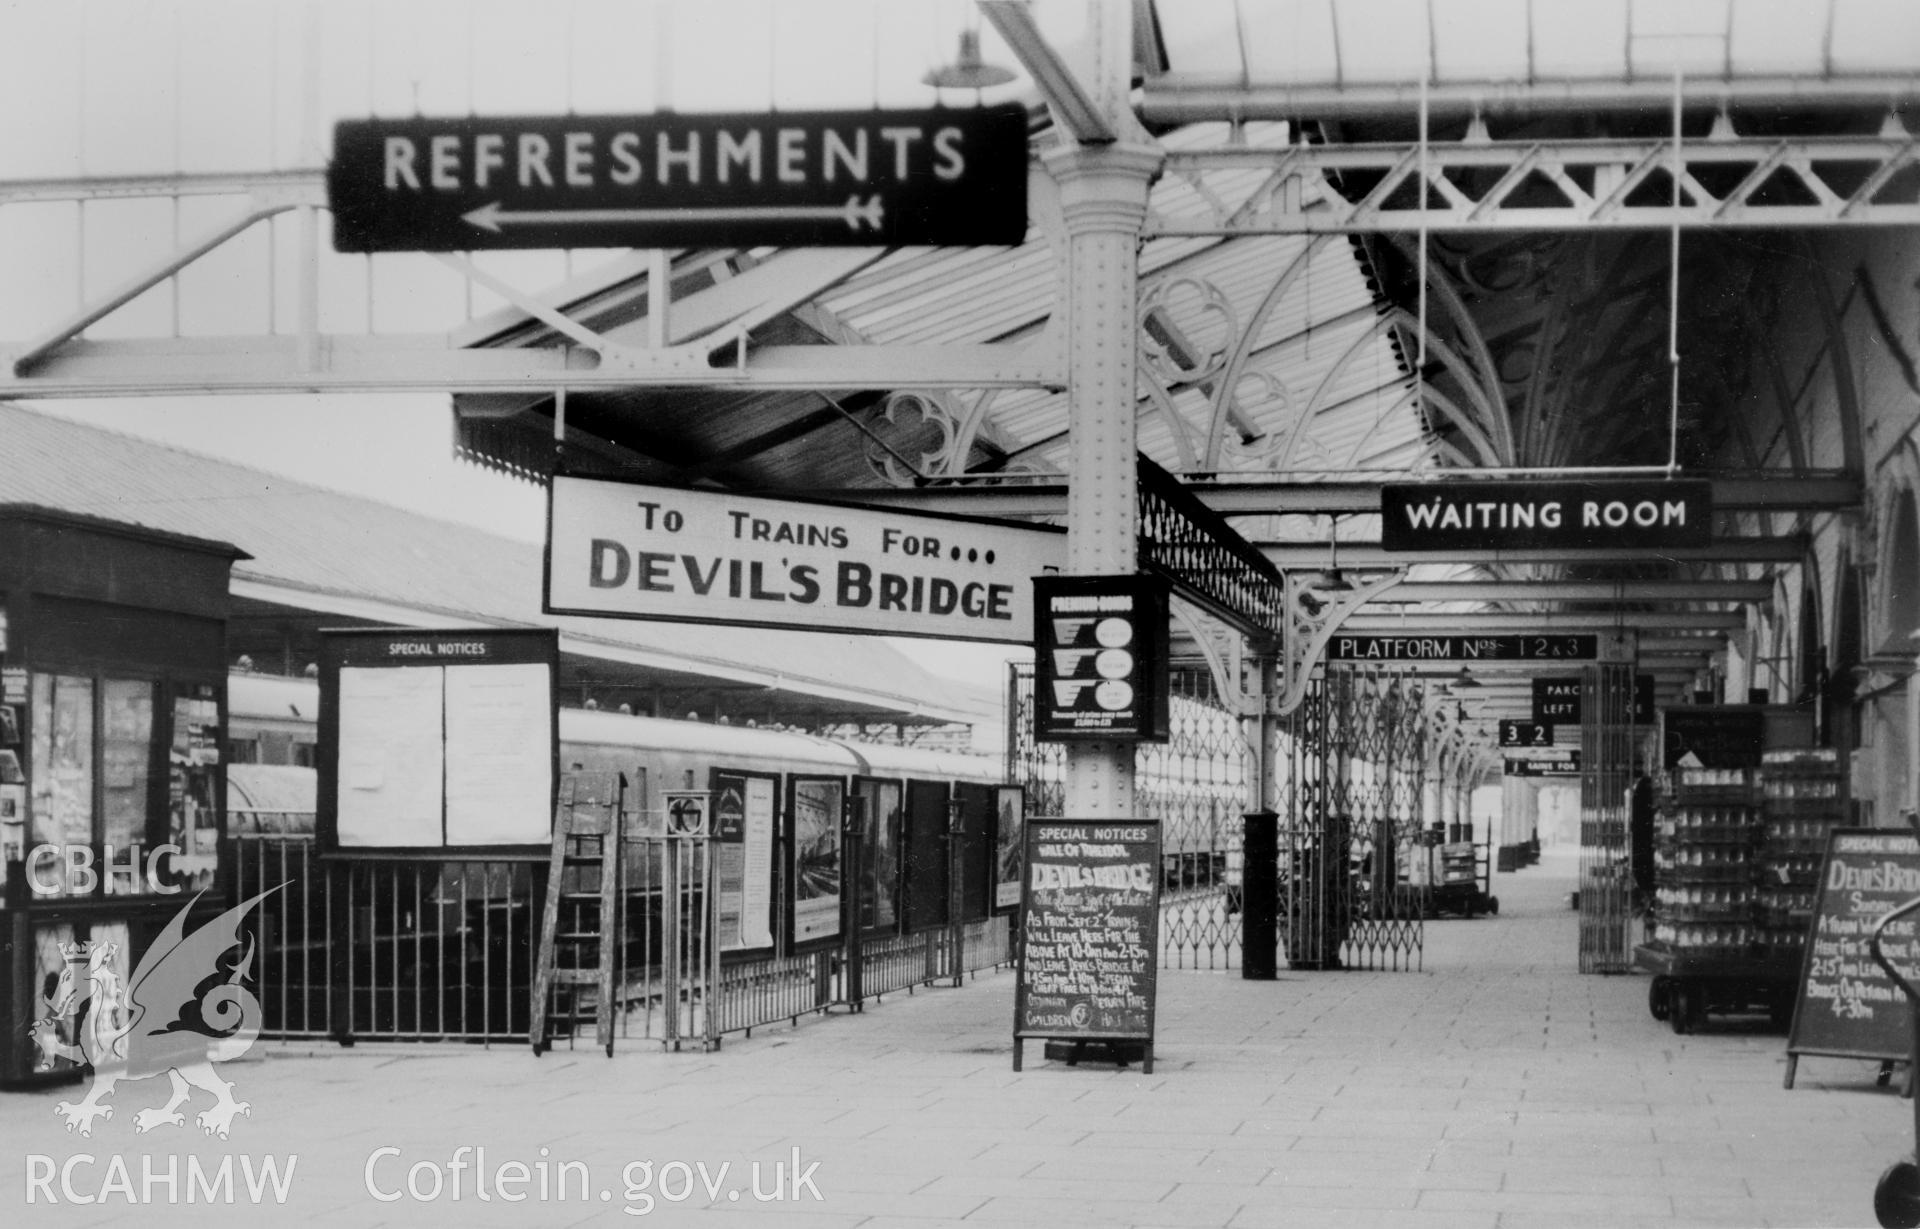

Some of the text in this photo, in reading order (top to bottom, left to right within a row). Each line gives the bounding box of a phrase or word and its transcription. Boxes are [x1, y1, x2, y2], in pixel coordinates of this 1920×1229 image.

[383, 126, 965, 189] REFRESHMENTS
[1406, 501, 1686, 529] WAITING ROOM
[589, 538, 1015, 620] DEVIL'S BRIDGE
[389, 642, 486, 655] SPECIAL NOTICES
[1340, 638, 1451, 658] PLATFORM
[1535, 637, 1547, 657] 2
[1567, 638, 1579, 656] 3
[1543, 704, 1574, 714] LEFT
[1508, 725, 1545, 741] 3 2
[1557, 761, 1576, 771] FOR
[1038, 828, 1148, 840] SPECIAL NOTICES
[1840, 838, 1884, 851] SPECIAL
[1092, 862, 1153, 892] BRIDGE
[1828, 860, 1920, 892] DEVIL'S BRID
[1026, 909, 1042, 927] AS
[1043, 911, 1067, 927] FROM
[1818, 914, 1827, 934] A
[1025, 926, 1142, 943] WILL LEAVE HERE FOR THE
[1025, 942, 1056, 959] ABOVE
[1057, 942, 1071, 959] AT
[1814, 937, 1839, 956] HERE
[1024, 957, 1041, 972] AND
[1041, 957, 1067, 972] LEAVE
[1095, 958, 1131, 973] BRIDGE
[1091, 994, 1125, 1009] RETURN
[1026, 1010, 1072, 1027] CHILDREN
